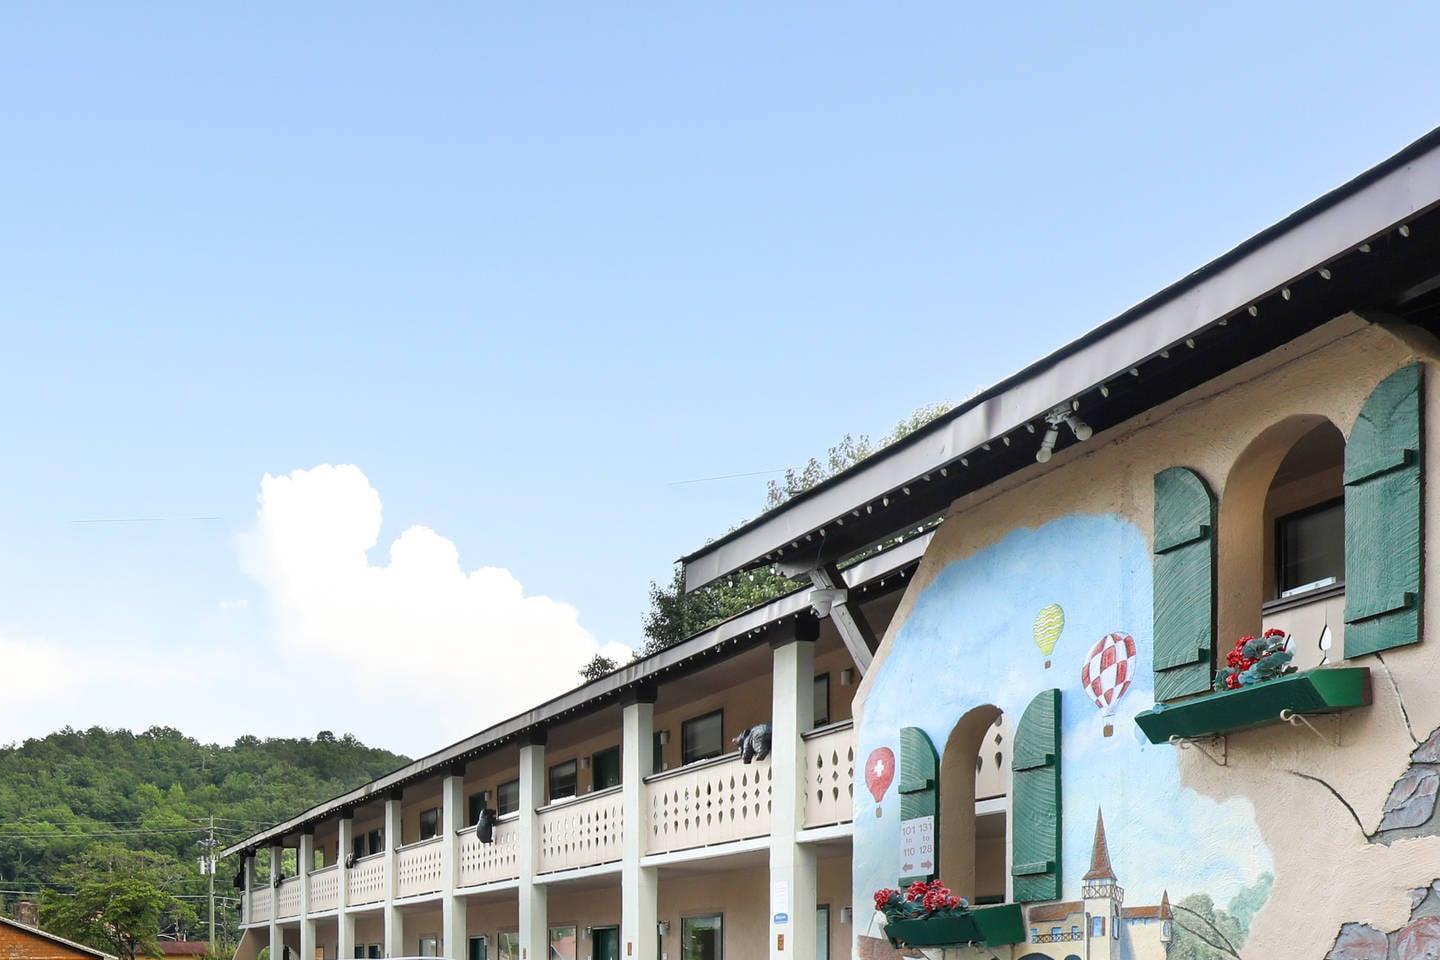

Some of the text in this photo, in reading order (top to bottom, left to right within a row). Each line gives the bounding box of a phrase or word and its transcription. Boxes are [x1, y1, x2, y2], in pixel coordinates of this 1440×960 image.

[903, 823, 916, 835] 101
[919, 822, 932, 832] 131
[904, 848, 915, 856] 110
